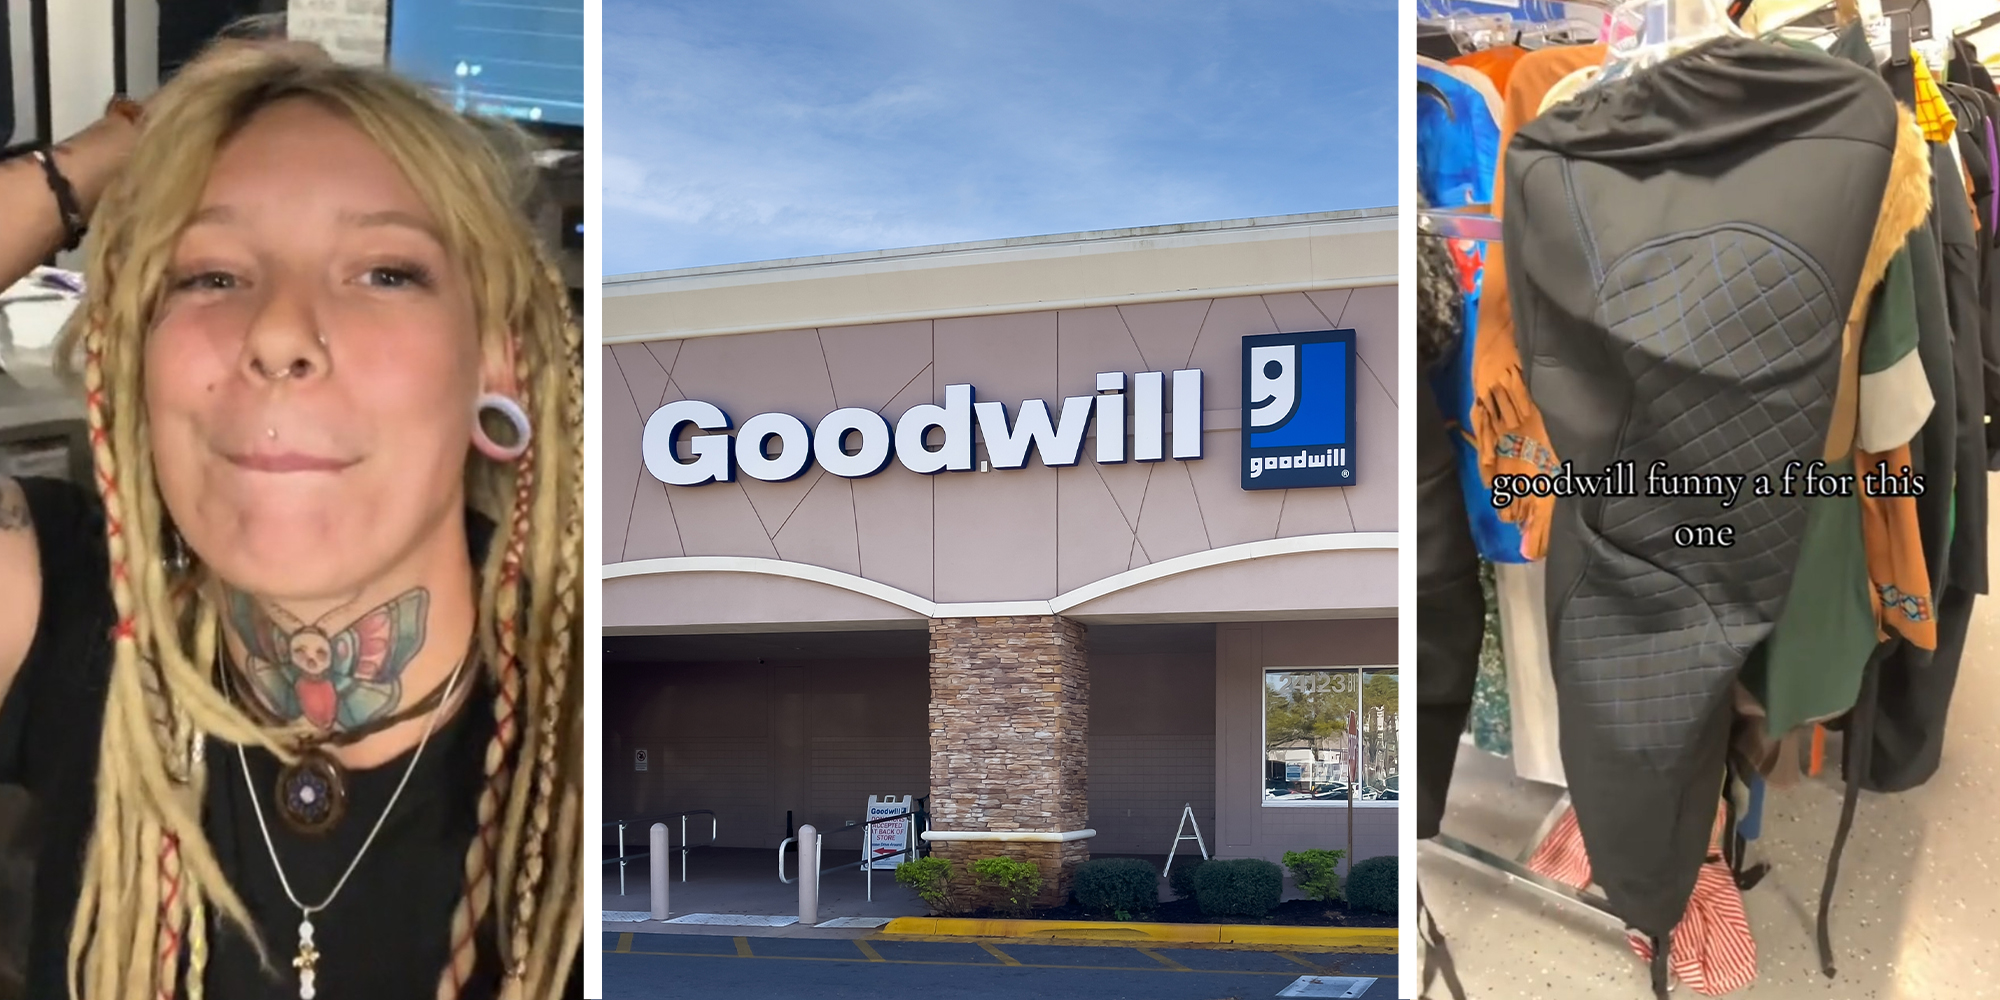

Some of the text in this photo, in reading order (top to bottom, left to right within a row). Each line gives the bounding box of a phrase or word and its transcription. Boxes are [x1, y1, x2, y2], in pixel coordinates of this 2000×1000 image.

[641, 368, 1204, 487] Goodwill
[1250, 448, 1346, 478] goodwill
[1279, 674, 1346, 693] 24123
